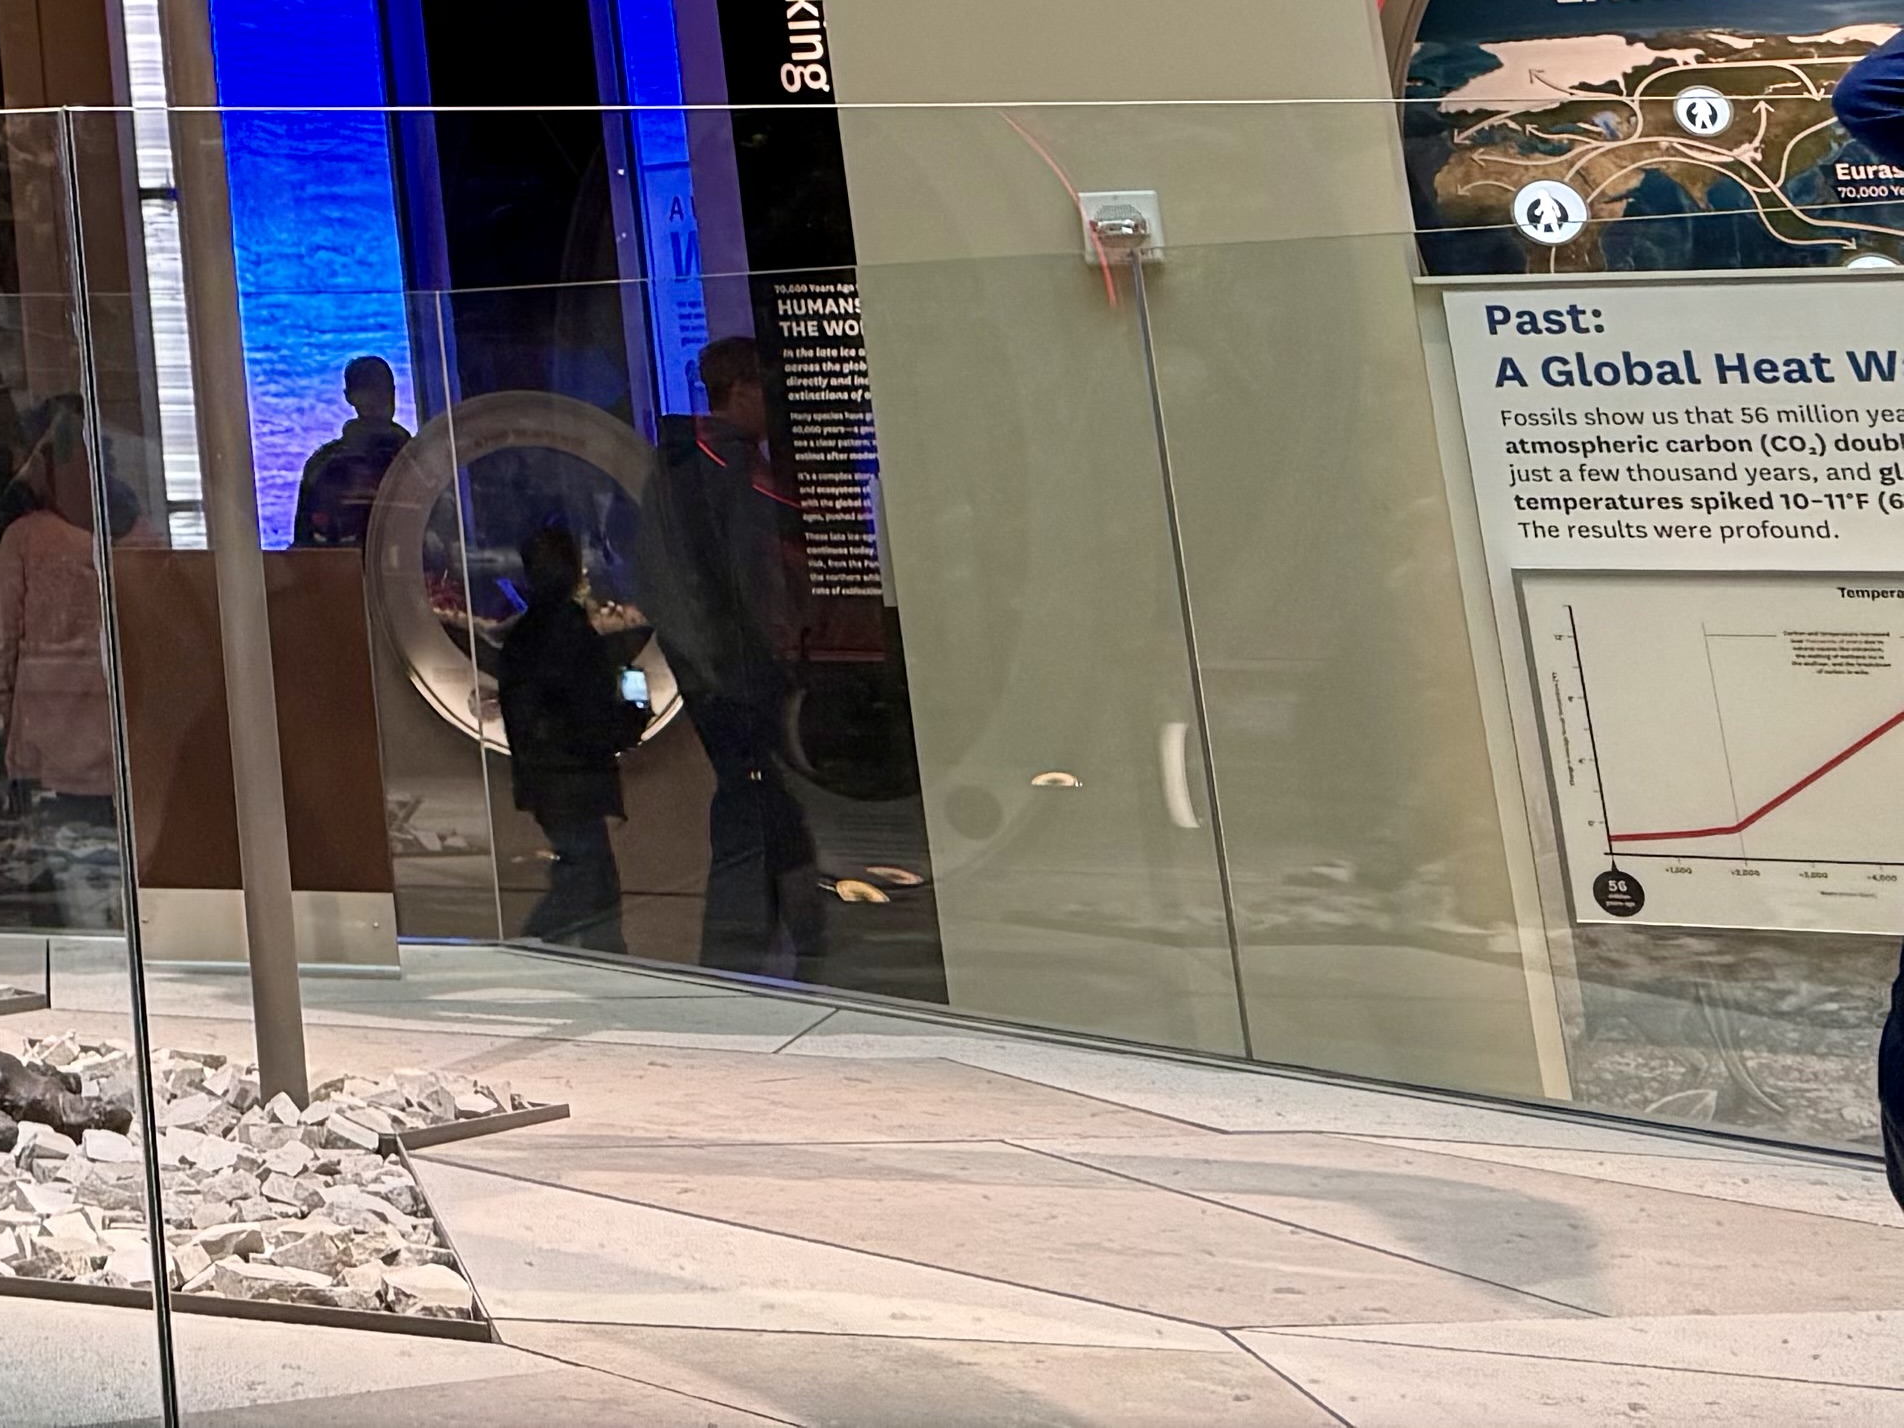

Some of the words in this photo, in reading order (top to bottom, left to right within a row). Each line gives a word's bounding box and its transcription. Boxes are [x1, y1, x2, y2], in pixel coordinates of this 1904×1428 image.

[1837, 186, 1888, 198] 70,000
[809, 284, 835, 293] Years
[837, 283, 855, 294] Ago
[1485, 304, 1605, 335] Past:
[779, 321, 819, 337] THE
[823, 319, 864, 336] WO
[783, 349, 794, 358] In
[796, 348, 814, 358] the
[816, 347, 838, 358] late
[840, 346, 856, 357] ice
[784, 363, 821, 372] across
[822, 362, 841, 372] the
[1495, 357, 1529, 388] A
[1541, 350, 1701, 387] Global
[1714, 352, 1835, 384] Heat
[1846, 350, 1904, 382] W
[786, 376, 828, 388] directly
[830, 376, 852, 386] and
[788, 390, 848, 401] extinctions
[850, 389, 863, 402] of
[1500, 407, 1578, 427] Fossils
[1584, 407, 1644, 426] show
[1652, 410, 1679, 425] us
[1684, 406, 1734, 424] that
[1741, 406, 1769, 424] 56
[1777, 404, 1859, 424] million
[1505, 434, 1659, 458] atmospheric
[1666, 434, 1753, 453] carbon
[827, 452, 848, 460] after
[1509, 463, 1553, 487] just
[1559, 468, 1573, 482] a
[1579, 463, 1620, 482] few
[1627, 462, 1738, 482] thousand
[1745, 466, 1819, 486] years,
[1826, 462, 1872, 482] and
[1514, 494, 1684, 515] temperatures
[1691, 491, 1774, 515] spiked
[1517, 520, 1560, 539] The
[1567, 520, 1648, 539] results
[1654, 524, 1712, 539] were
[1720, 520, 1839, 544] profound.
[1608, 880, 1628, 892] 56
